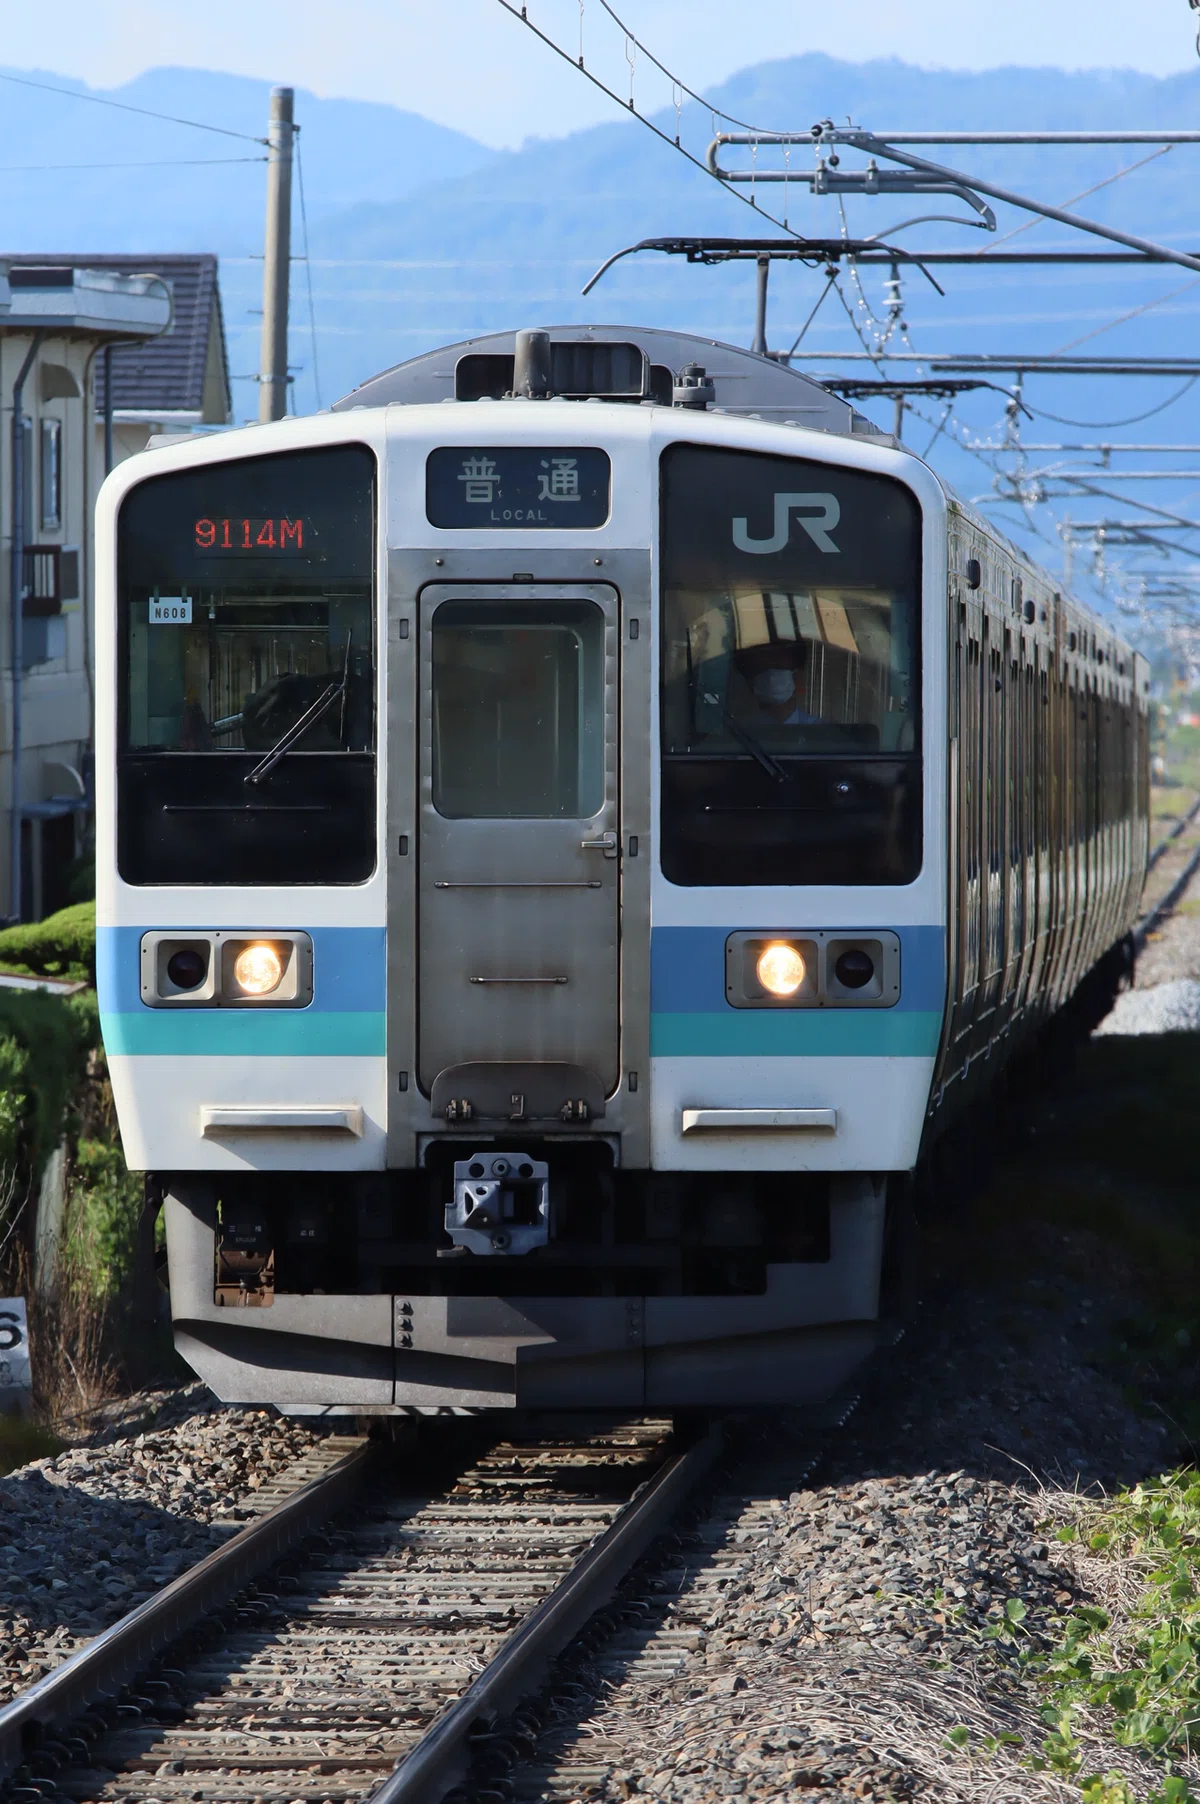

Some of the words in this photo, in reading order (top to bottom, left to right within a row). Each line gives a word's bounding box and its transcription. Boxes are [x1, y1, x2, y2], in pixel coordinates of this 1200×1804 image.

[457, 456, 582, 503] 普通
[490, 509, 547, 521] LOCAL
[732, 492, 841, 554] JR
[195, 518, 303, 549] 9114M
[155, 607, 186, 619] N608
